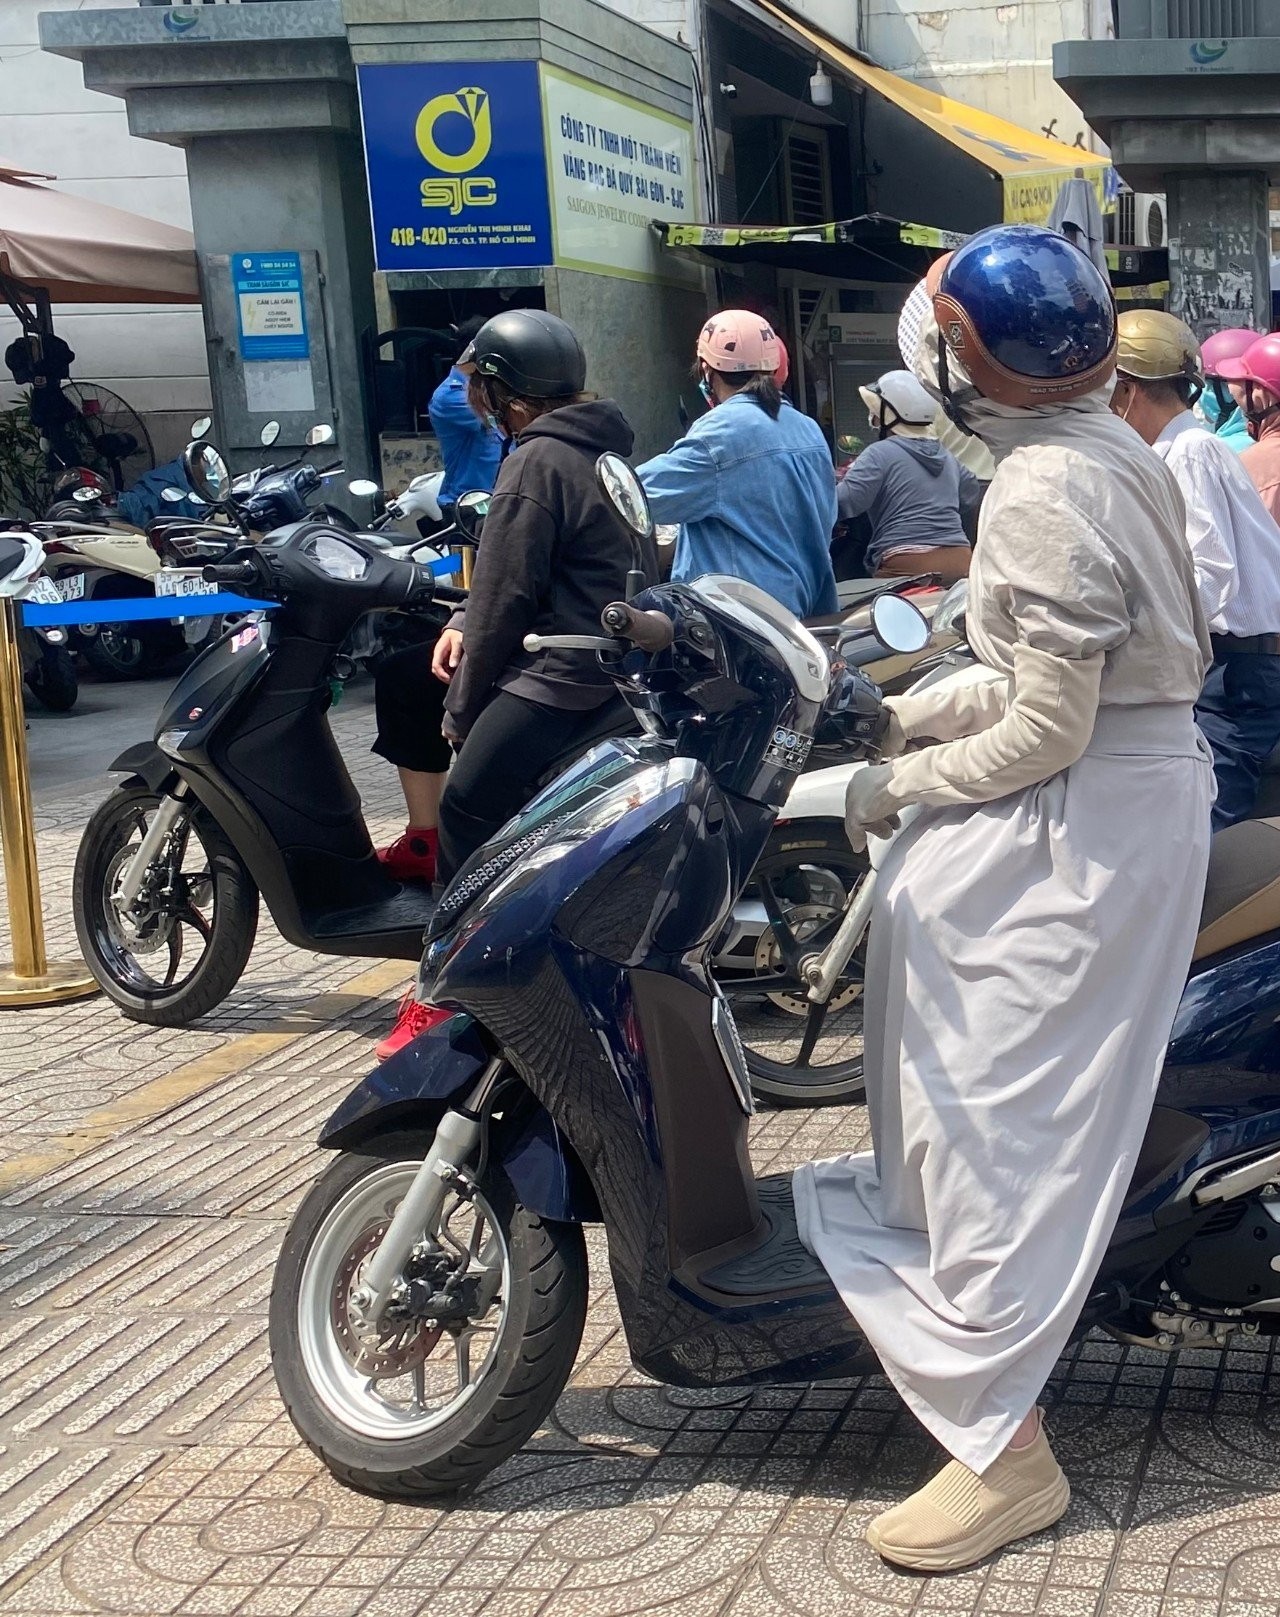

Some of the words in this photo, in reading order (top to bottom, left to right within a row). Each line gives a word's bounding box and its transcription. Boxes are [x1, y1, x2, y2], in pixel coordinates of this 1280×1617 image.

[560, 112, 584, 143] CÔNG
[586, 123, 597, 147] TY
[599, 128, 620, 155] TNHH
[621, 135, 638, 165] MỘT
[639, 141, 664, 170] THÀNH
[563, 150, 586, 181] VÀNG
[619, 169, 634, 196] QUÝ
[635, 173, 649, 200] SÀI
[671, 187, 685, 209] SJC
[567, 195, 597, 217] SAIGON
[597, 203, 627, 224] JEWELRY
[391, 226, 447, 247] 418-420
[492, 225, 512, 233] MINH
[513, 224, 532, 233] KHAI
[516, 235, 536, 244] MINH
